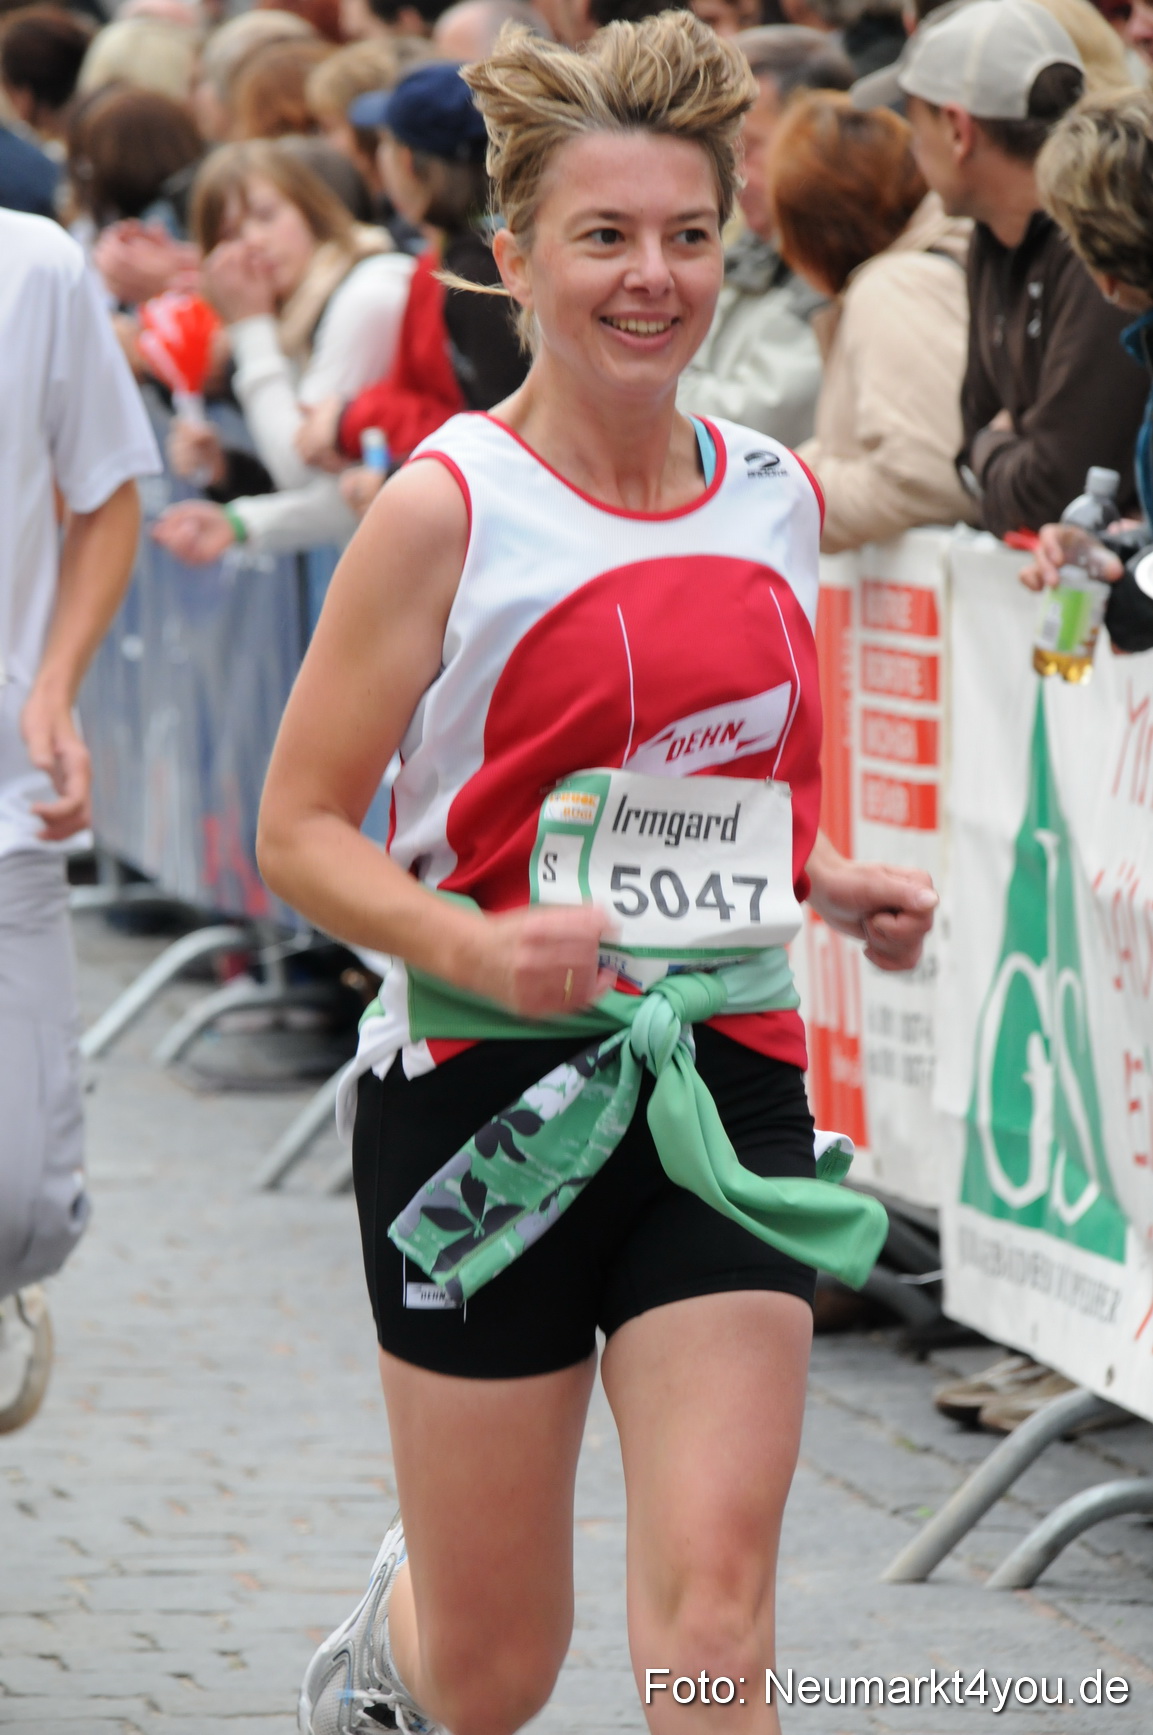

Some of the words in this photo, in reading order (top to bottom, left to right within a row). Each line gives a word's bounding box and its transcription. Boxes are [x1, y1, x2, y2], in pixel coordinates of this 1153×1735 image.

[666, 719, 745, 762] DEHN
[612, 794, 741, 847] Irmgard
[610, 864, 768, 925] 5047
